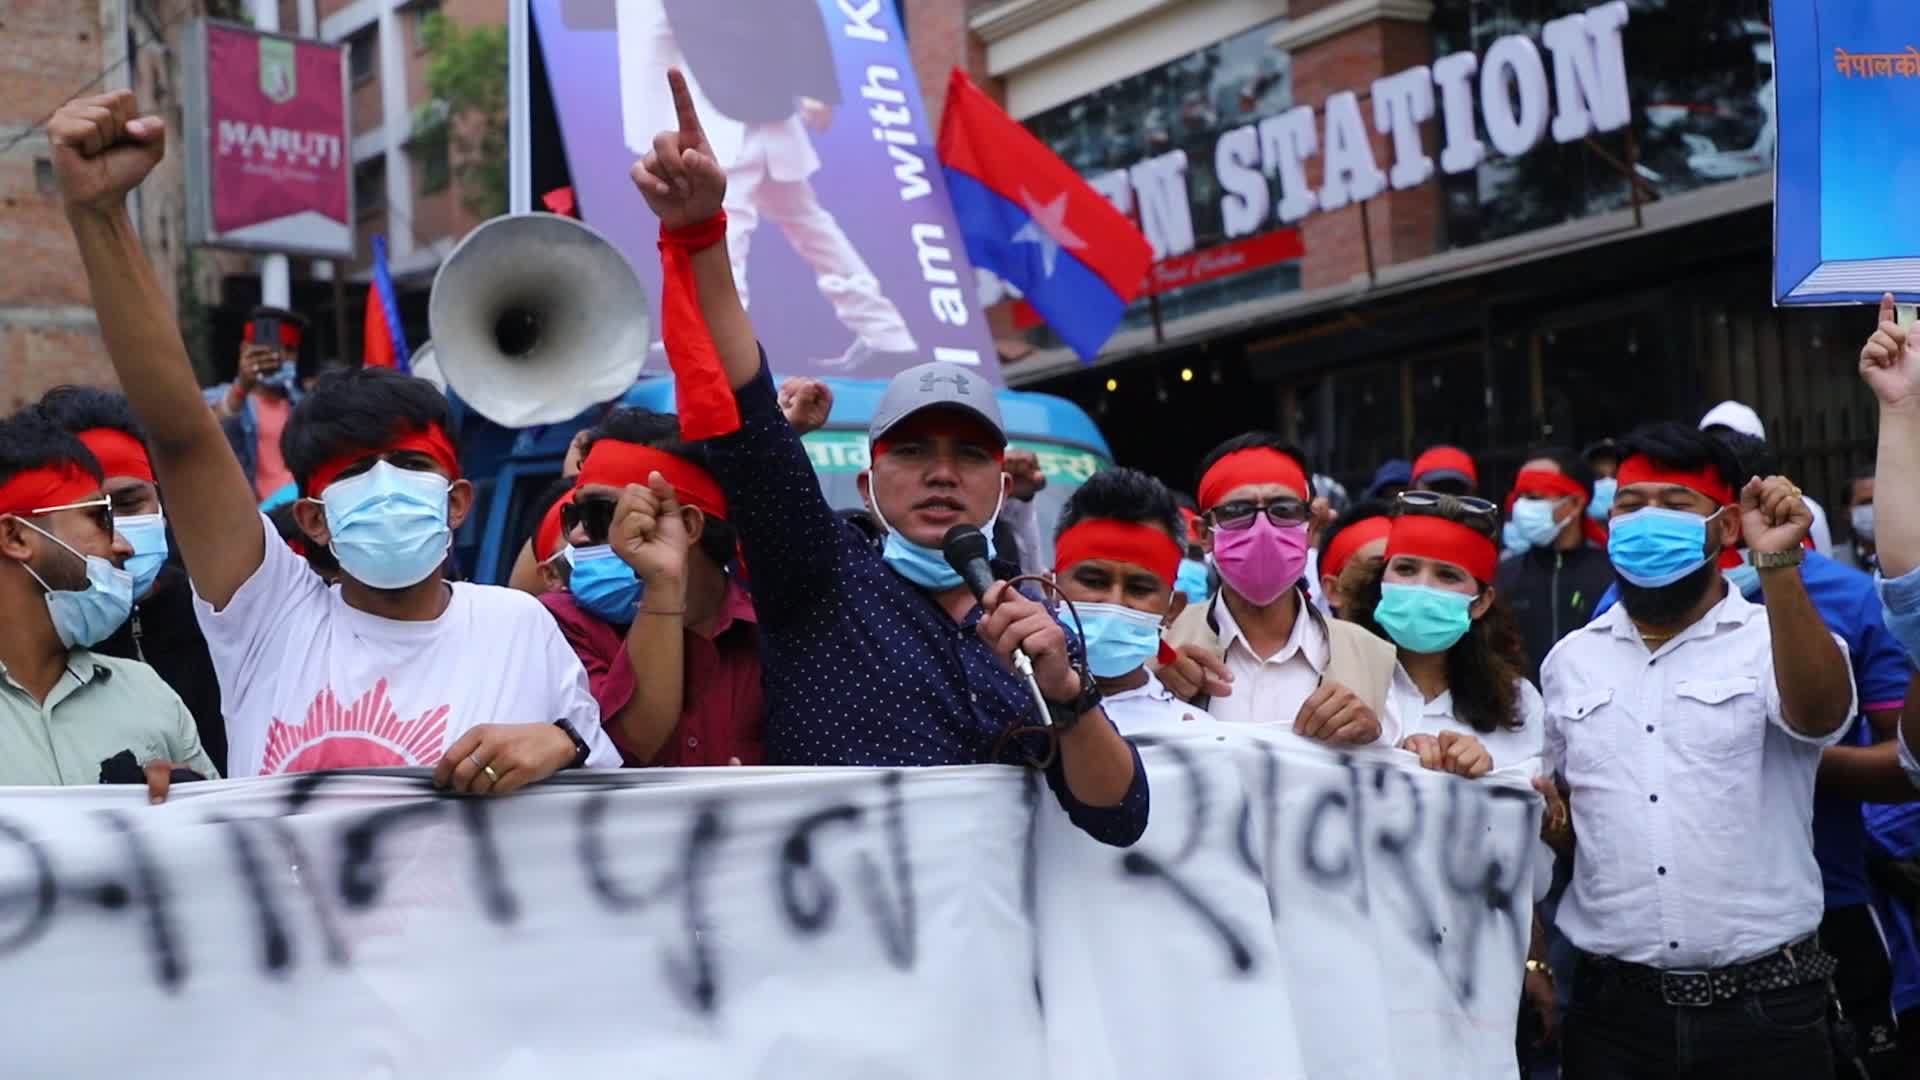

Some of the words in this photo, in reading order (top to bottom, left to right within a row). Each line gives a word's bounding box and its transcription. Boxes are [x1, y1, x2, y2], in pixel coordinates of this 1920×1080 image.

[218, 119, 340, 160] MARUTI
[860, 64, 932, 200] with
[1214, 1, 1631, 239] STATION
[910, 222, 969, 327] am
[933, 346, 982, 366] I
